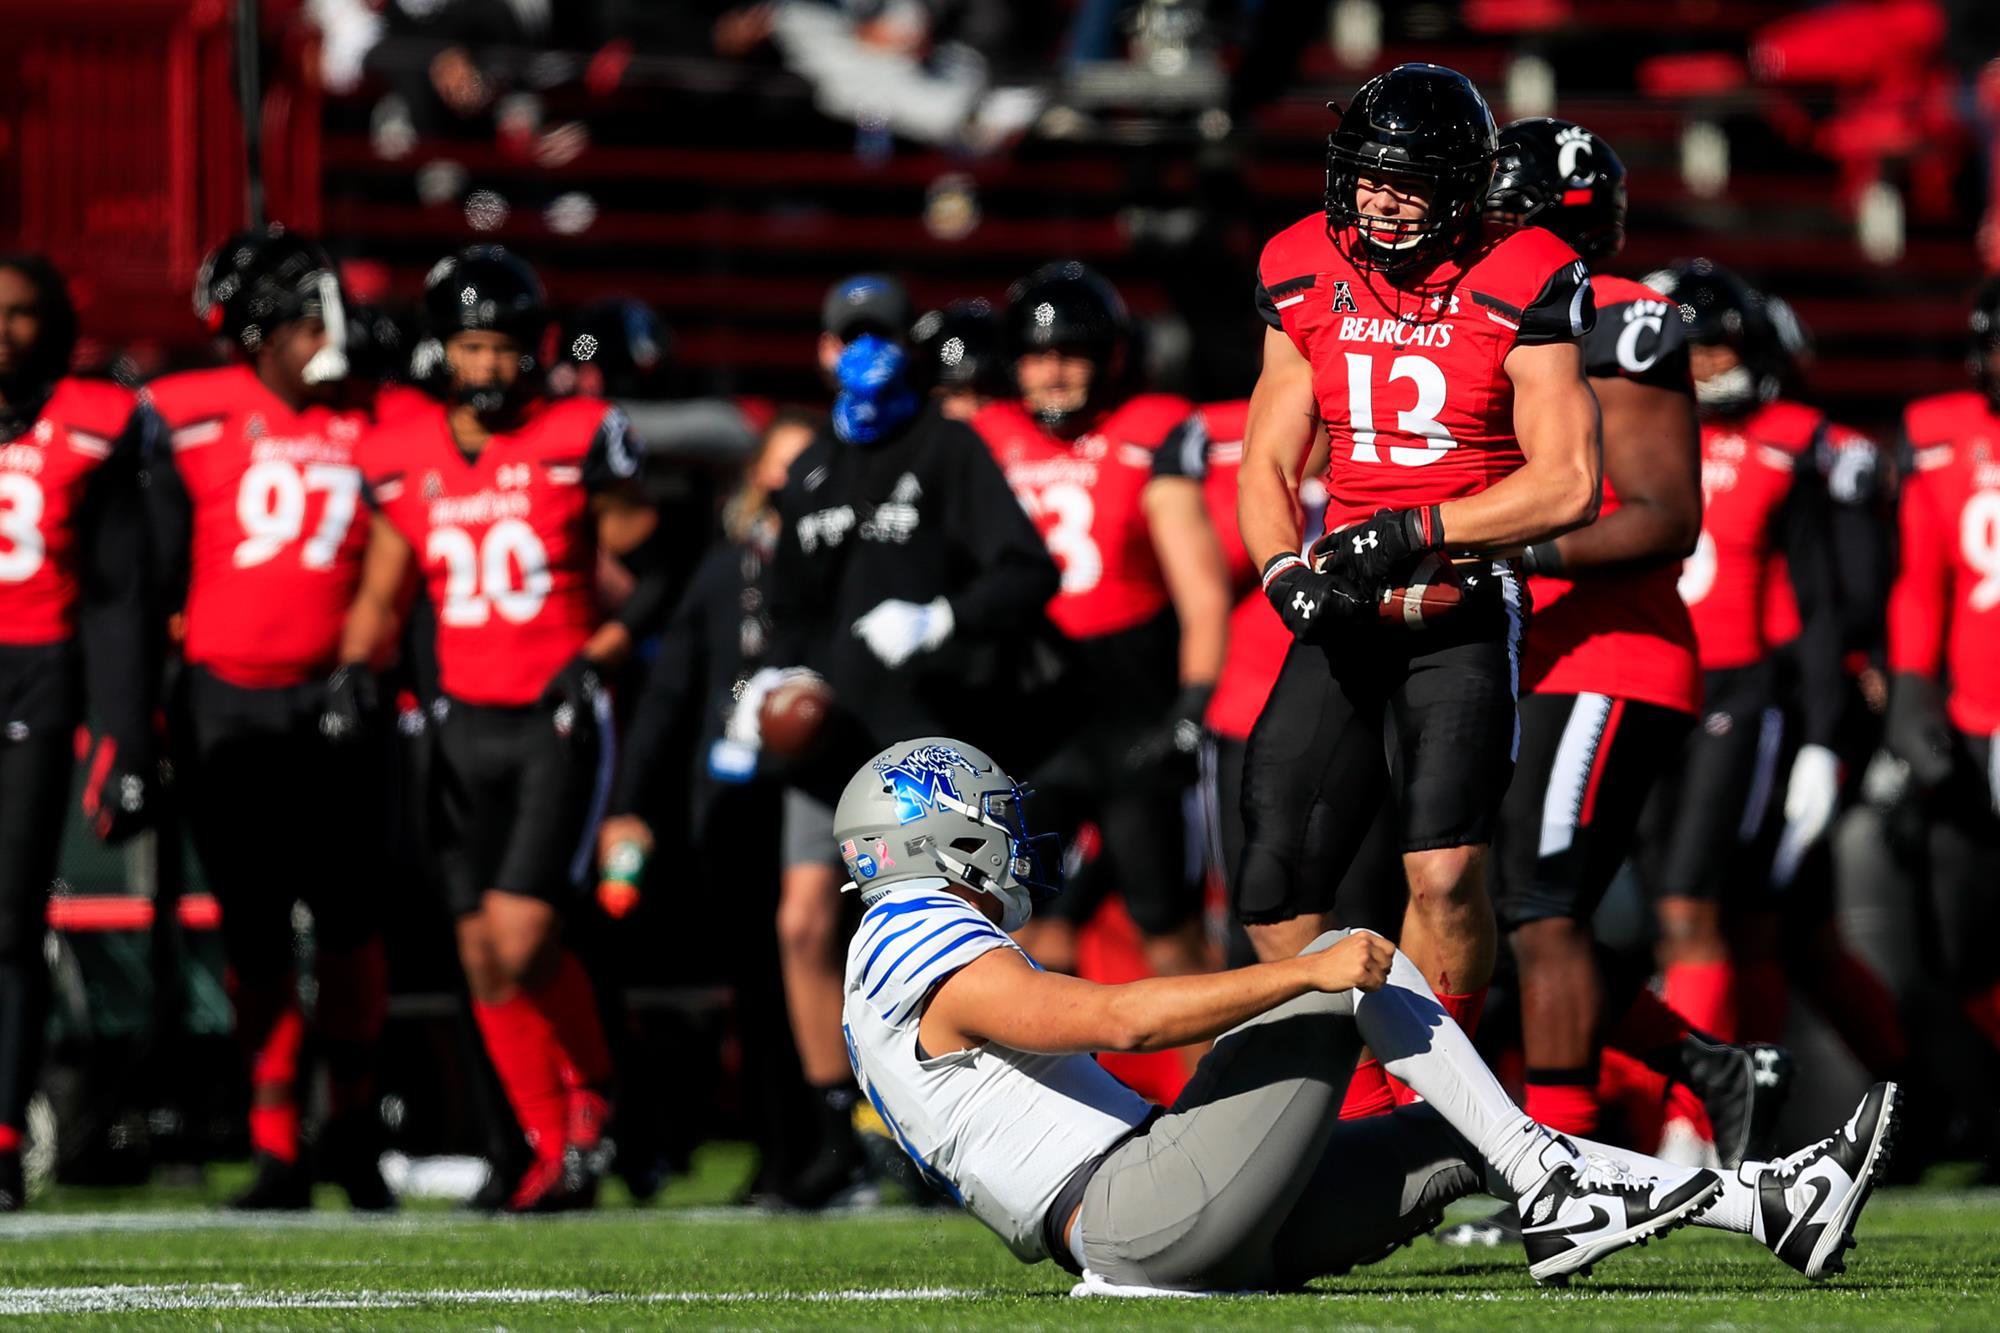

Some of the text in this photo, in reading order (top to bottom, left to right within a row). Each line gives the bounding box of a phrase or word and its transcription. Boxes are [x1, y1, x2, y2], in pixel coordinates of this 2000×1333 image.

[1338, 316, 1453, 348] BEARCATS
[1344, 352, 1458, 467] 13
[233, 460, 363, 571] 97
[426, 518, 553, 627] 20
